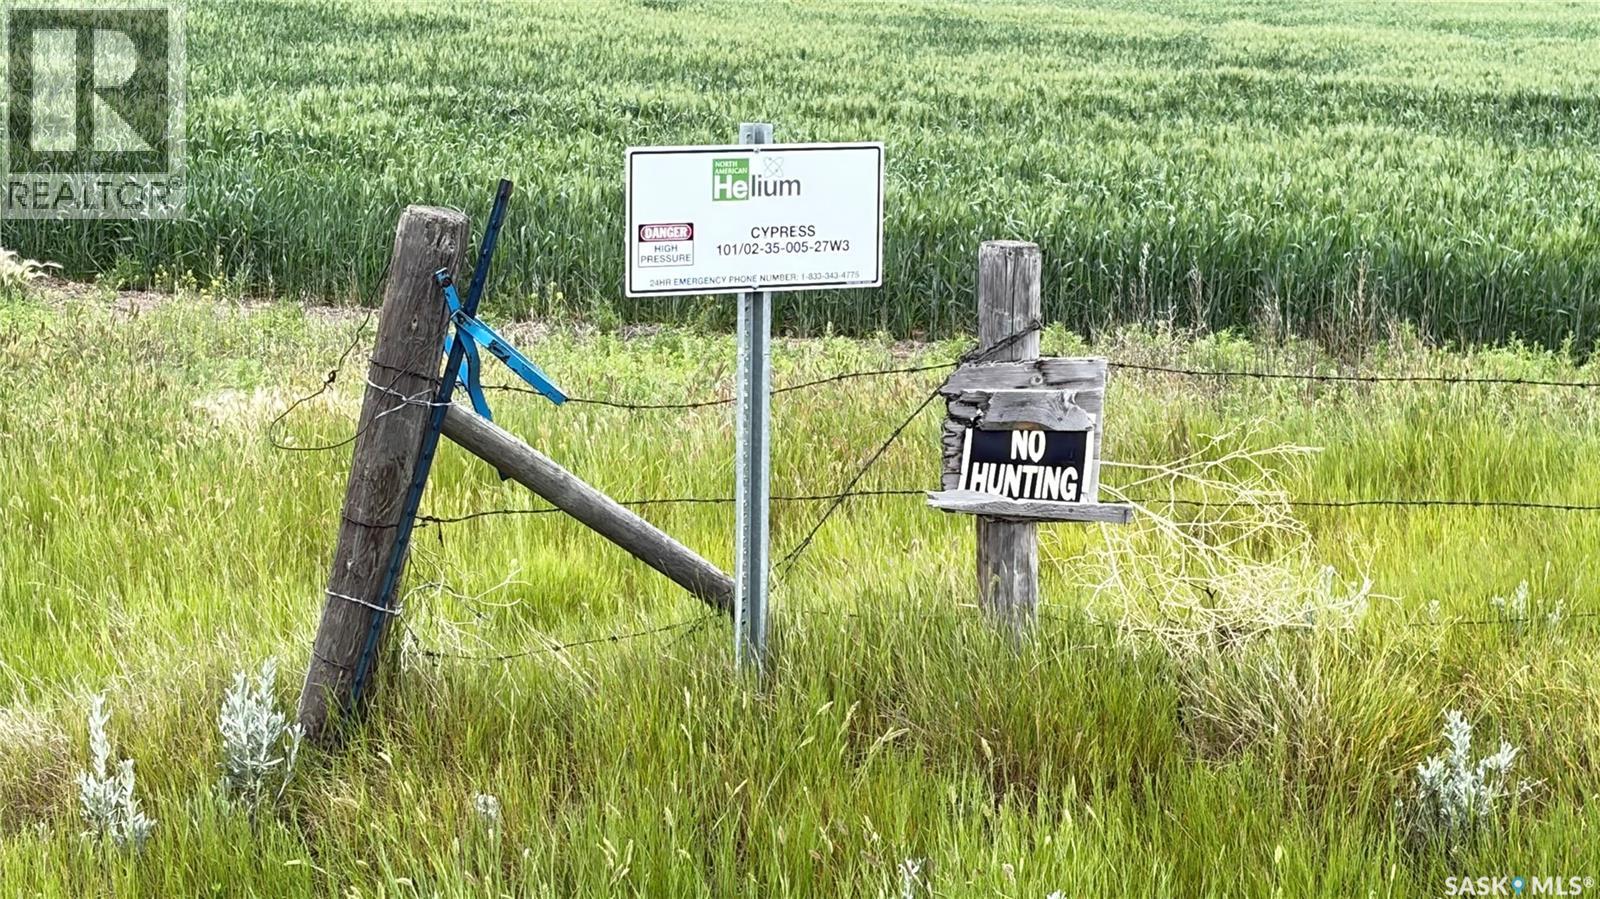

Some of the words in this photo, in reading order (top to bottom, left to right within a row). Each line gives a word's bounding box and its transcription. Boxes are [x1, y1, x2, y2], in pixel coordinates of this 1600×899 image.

[715, 160, 738, 168] NORTH
[715, 167, 748, 175] AMERICAN
[713, 174, 801, 200] Helium
[645, 226, 688, 239] DANGER
[750, 225, 816, 239] CYPRESS
[654, 244, 678, 253] HIGH
[717, 239, 850, 256] 101/02-35-005-27W3
[640, 253, 692, 263] PRESSURE
[649, 279, 672, 287] 24HR
[673, 276, 727, 286] EMERGENCY
[728, 275, 758, 283] PHONE
[759, 273, 799, 282] NUMBER:
[1010, 430, 1046, 463] NO
[969, 462, 1079, 501] HUNTING
